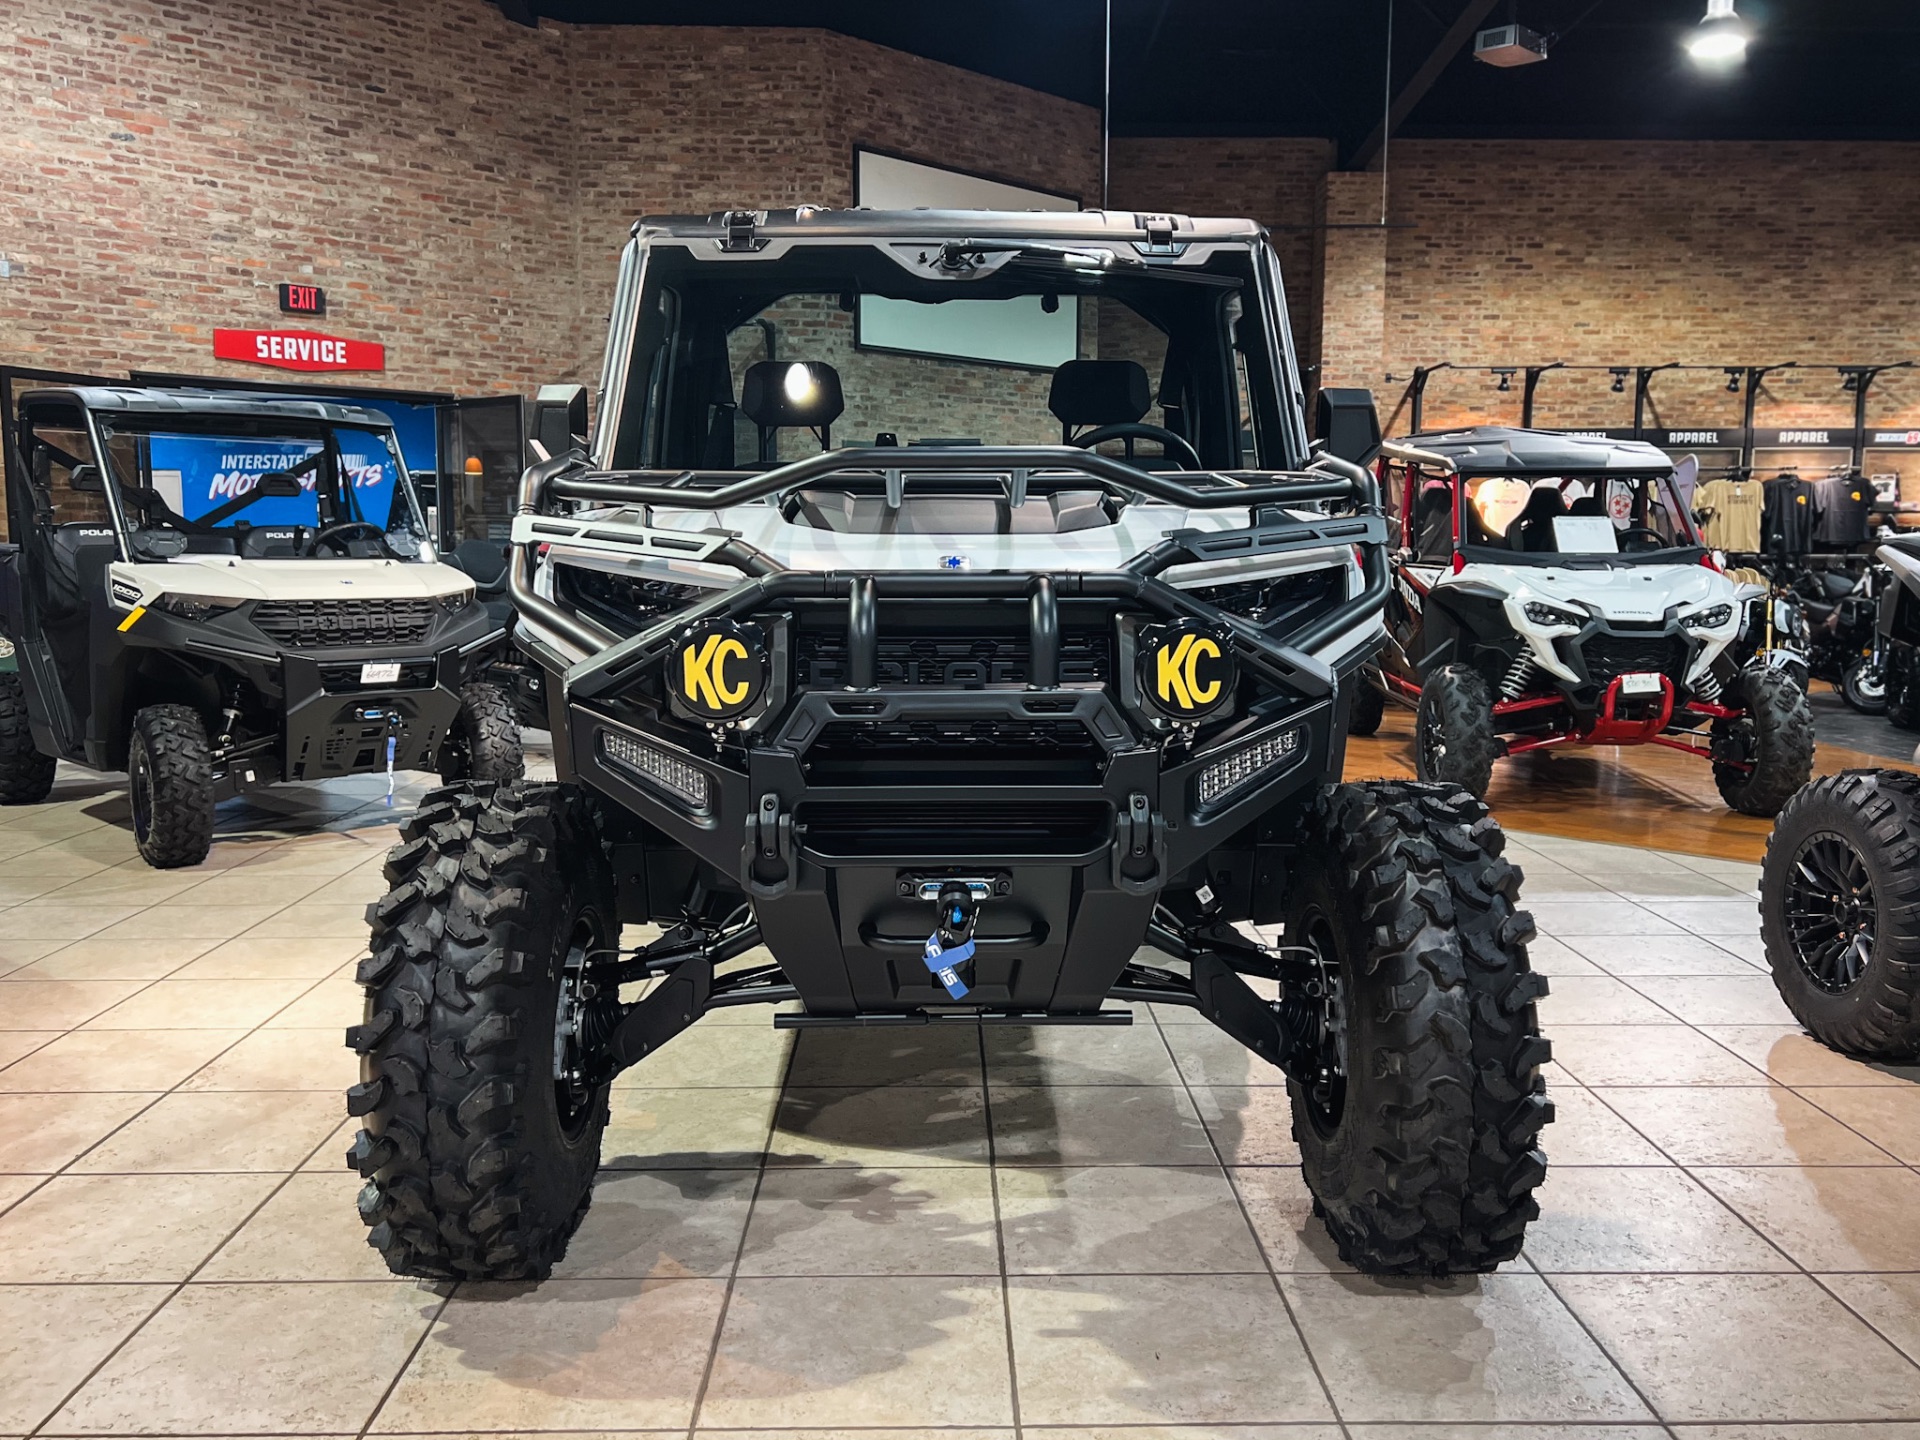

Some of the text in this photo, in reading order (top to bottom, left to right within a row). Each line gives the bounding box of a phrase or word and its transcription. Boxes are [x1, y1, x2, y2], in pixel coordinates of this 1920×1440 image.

[289, 286, 317, 309] EXIT
[256, 335, 347, 363] SERVICE
[1669, 432, 1718, 443] APPAREL
[1779, 432, 1829, 443] APPAREL
[221, 455, 304, 469] INTERSTATE
[113, 583, 141, 598] 1000
[299, 614, 410, 630] POLARIS
[683, 634, 749, 709] KC
[1157, 634, 1221, 709] KC
